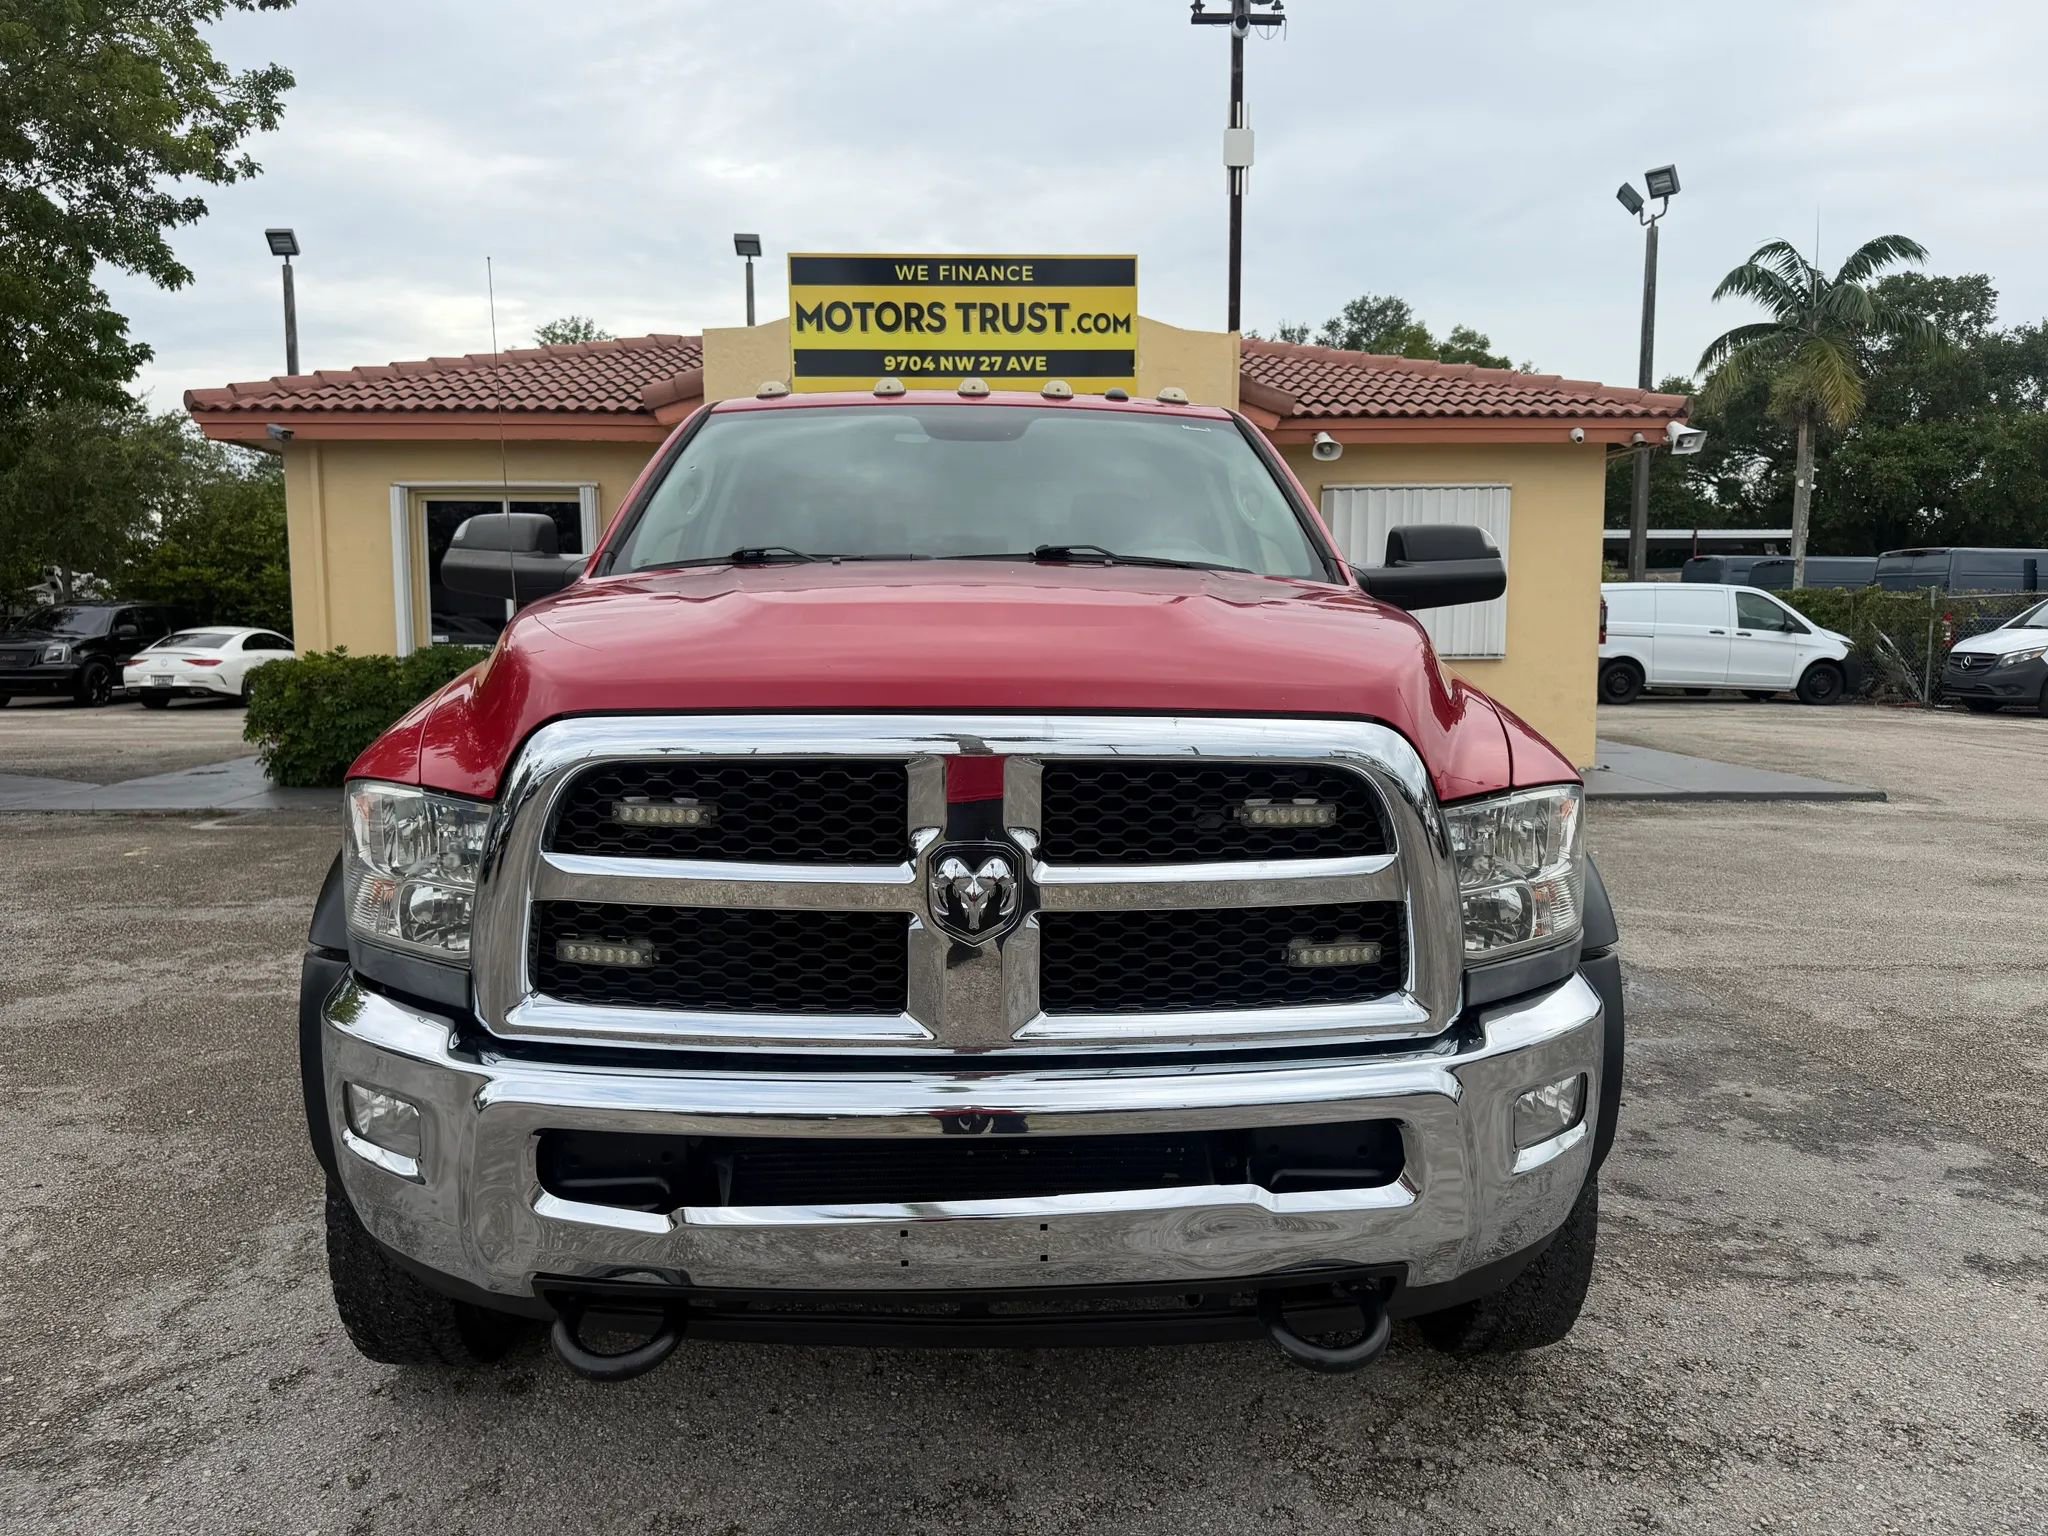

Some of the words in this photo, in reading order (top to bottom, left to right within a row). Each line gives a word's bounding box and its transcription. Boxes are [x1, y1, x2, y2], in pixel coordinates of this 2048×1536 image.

[894, 265, 929, 281] WE
[939, 265, 1034, 281] FINANCE
[795, 301, 947, 334] MOTORS
[884, 356, 936, 371] 9704
[940, 356, 975, 372] NW
[979, 356, 1003, 372] 27
[1007, 356, 1048, 372] AVE
